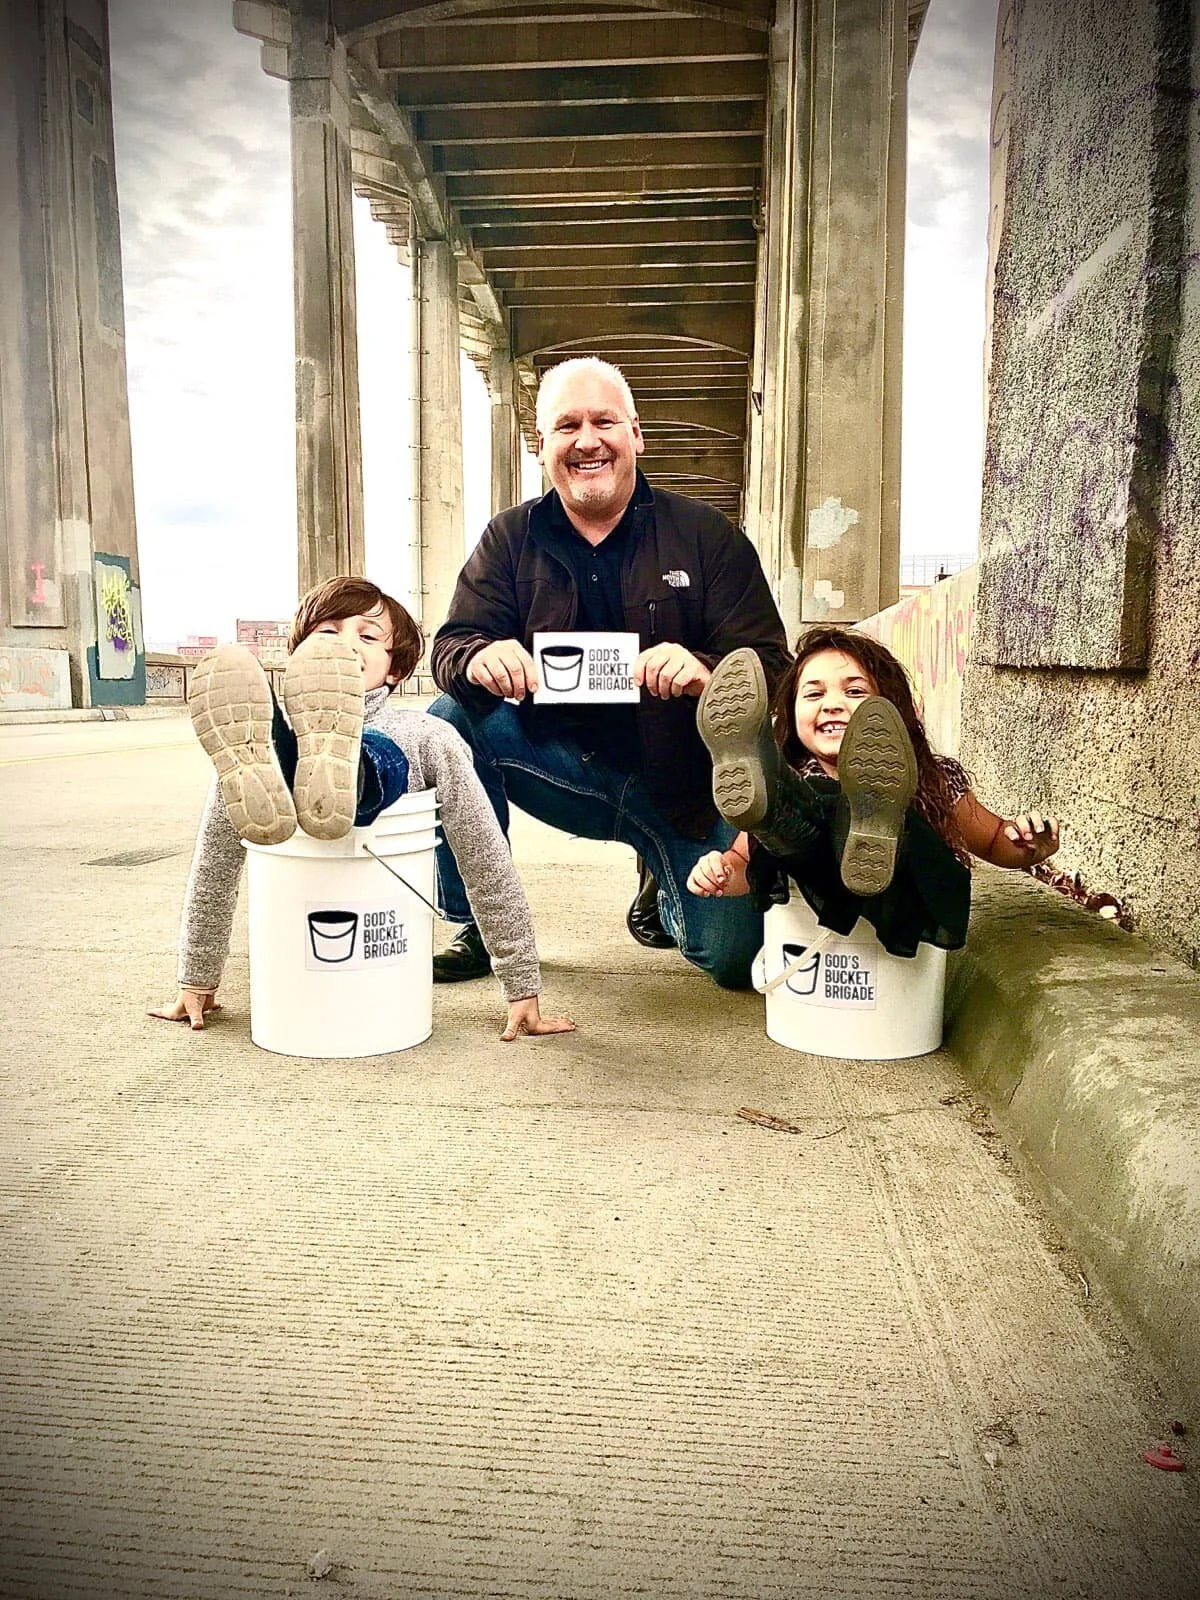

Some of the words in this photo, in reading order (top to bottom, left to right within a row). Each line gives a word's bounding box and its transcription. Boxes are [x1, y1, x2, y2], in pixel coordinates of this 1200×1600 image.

[588, 648, 620, 661] GOD'S
[588, 663, 629, 676] BUCKET
[588, 677, 634, 690] BRIGADE
[363, 910, 396, 928] GOD'S
[363, 923, 405, 944] BUCKET
[363, 938, 408, 960] BRIGADE
[824, 953, 860, 969] GOD'S
[824, 969, 870, 985] BUCKET
[824, 984, 874, 1001] BRIGADE
